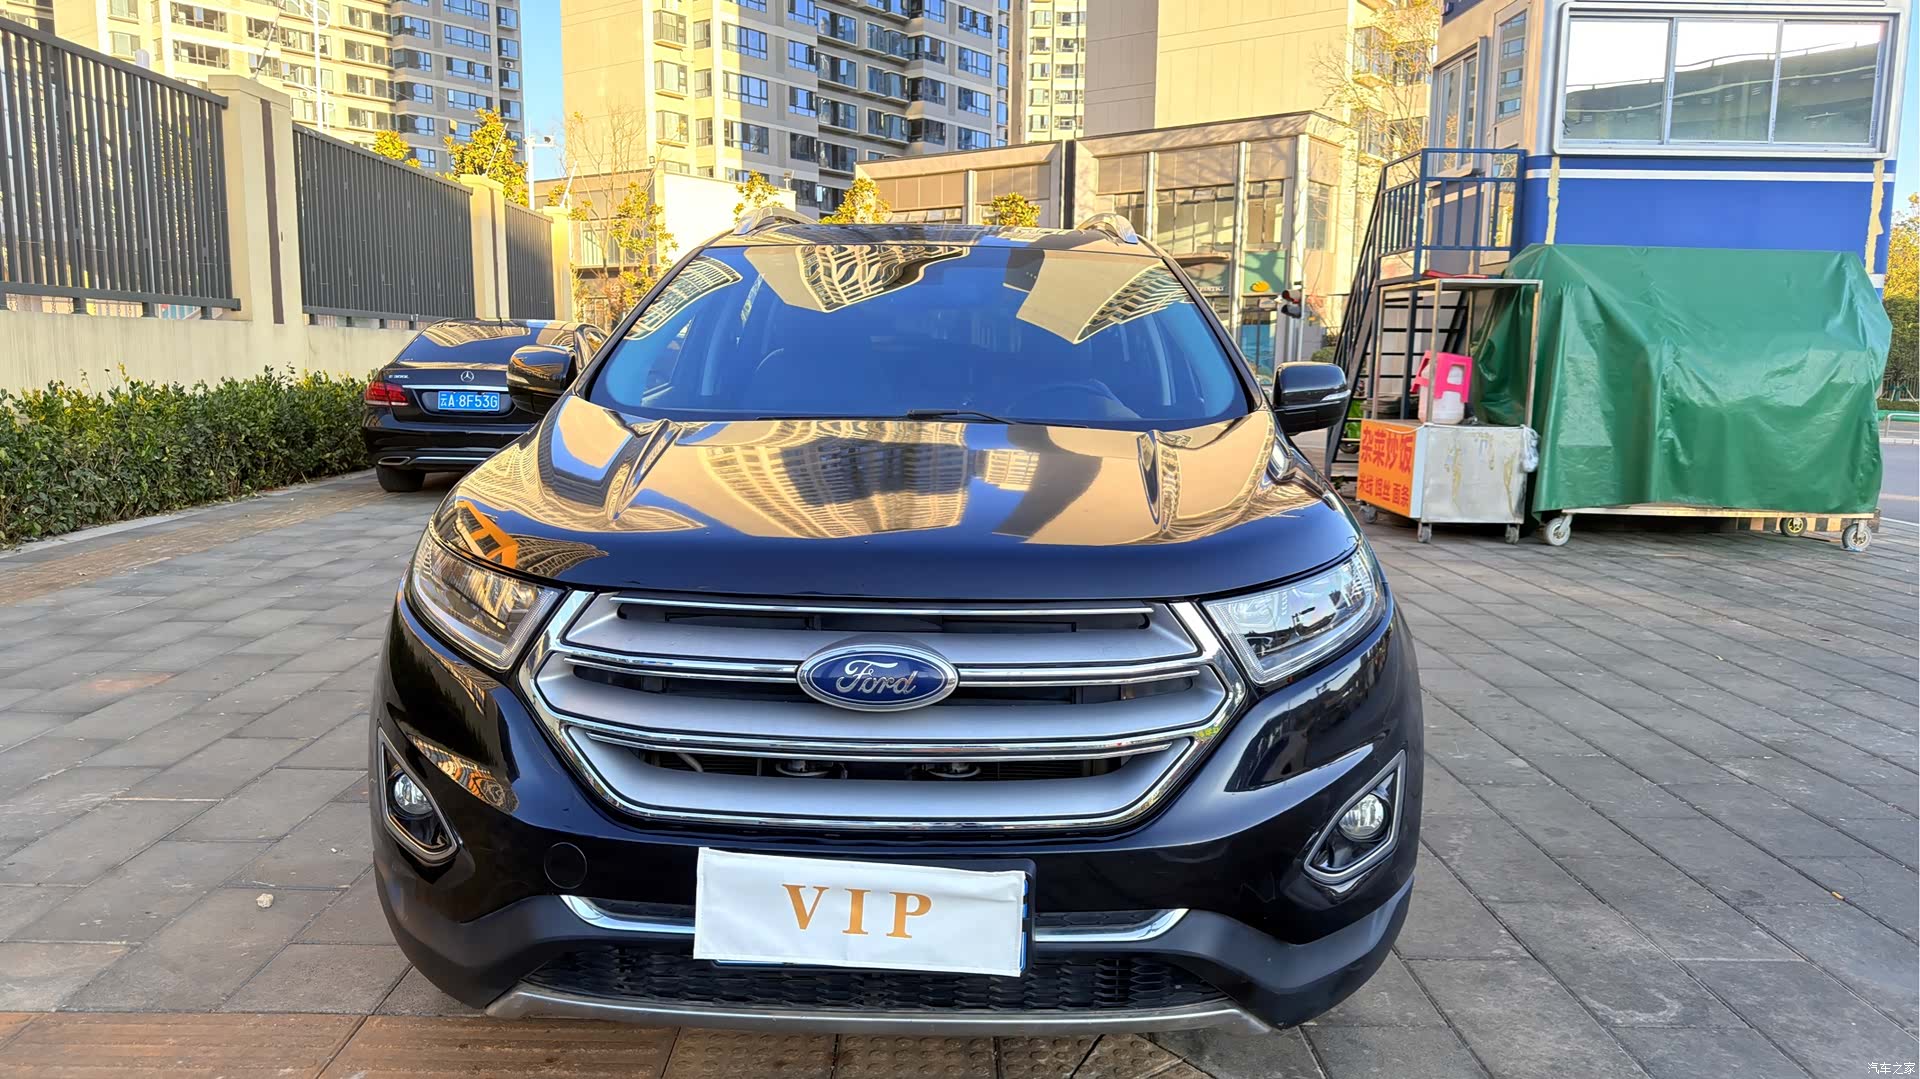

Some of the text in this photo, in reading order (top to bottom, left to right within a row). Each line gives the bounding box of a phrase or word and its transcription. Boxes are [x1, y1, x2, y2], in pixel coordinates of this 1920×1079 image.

[1361, 426, 1413, 475] 杂菜炒饭
[835, 659, 919, 694] Ford
[781, 884, 932, 939] VIP
